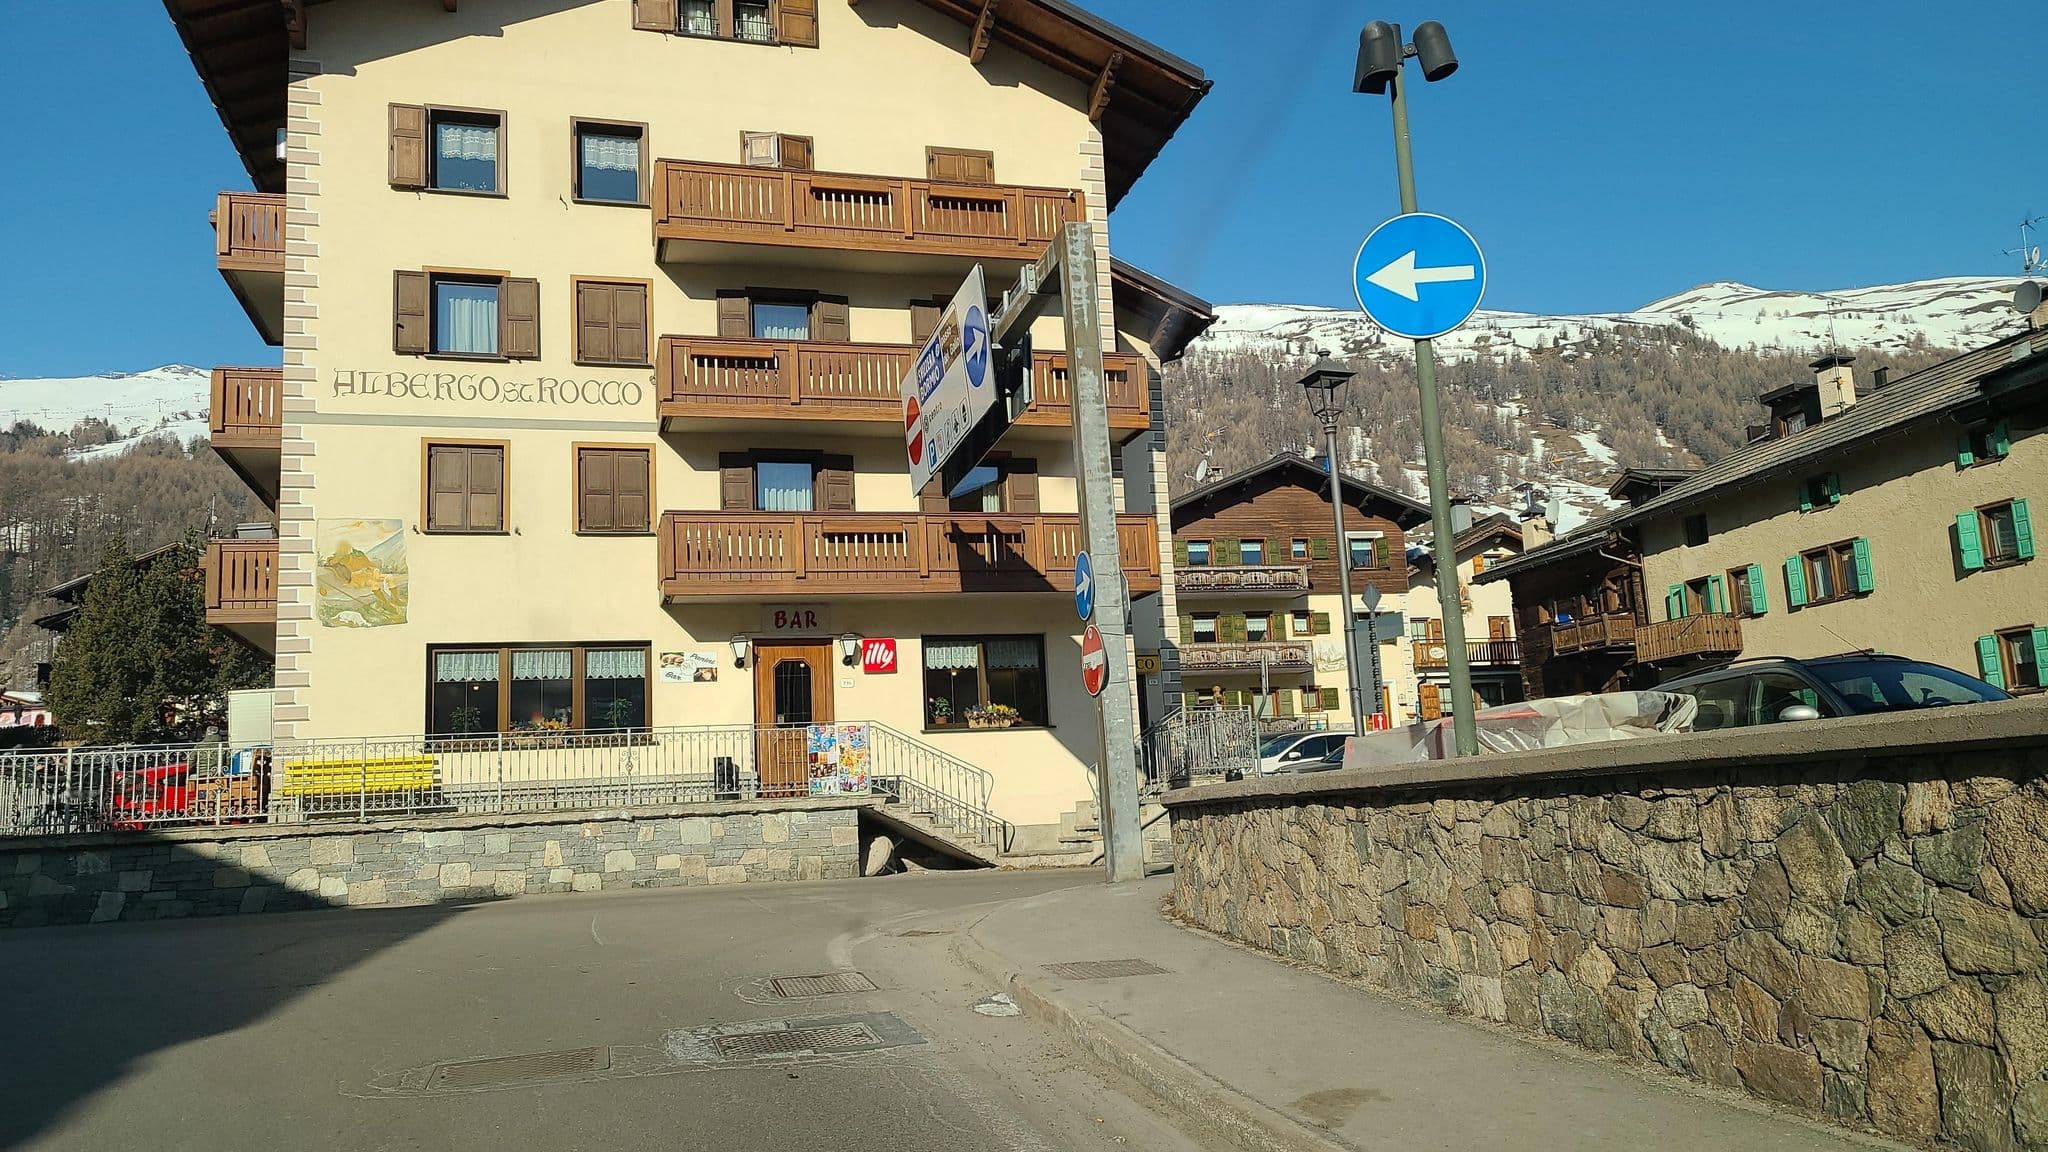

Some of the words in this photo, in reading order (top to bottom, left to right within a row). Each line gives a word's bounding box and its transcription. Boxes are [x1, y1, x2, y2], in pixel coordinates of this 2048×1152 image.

[332, 367, 500, 401] ALBERGO
[536, 376, 643, 406] ROCCO
[920, 365, 940, 401] BORMIO
[774, 609, 818, 630] BAR
[865, 642, 894, 669] illy
